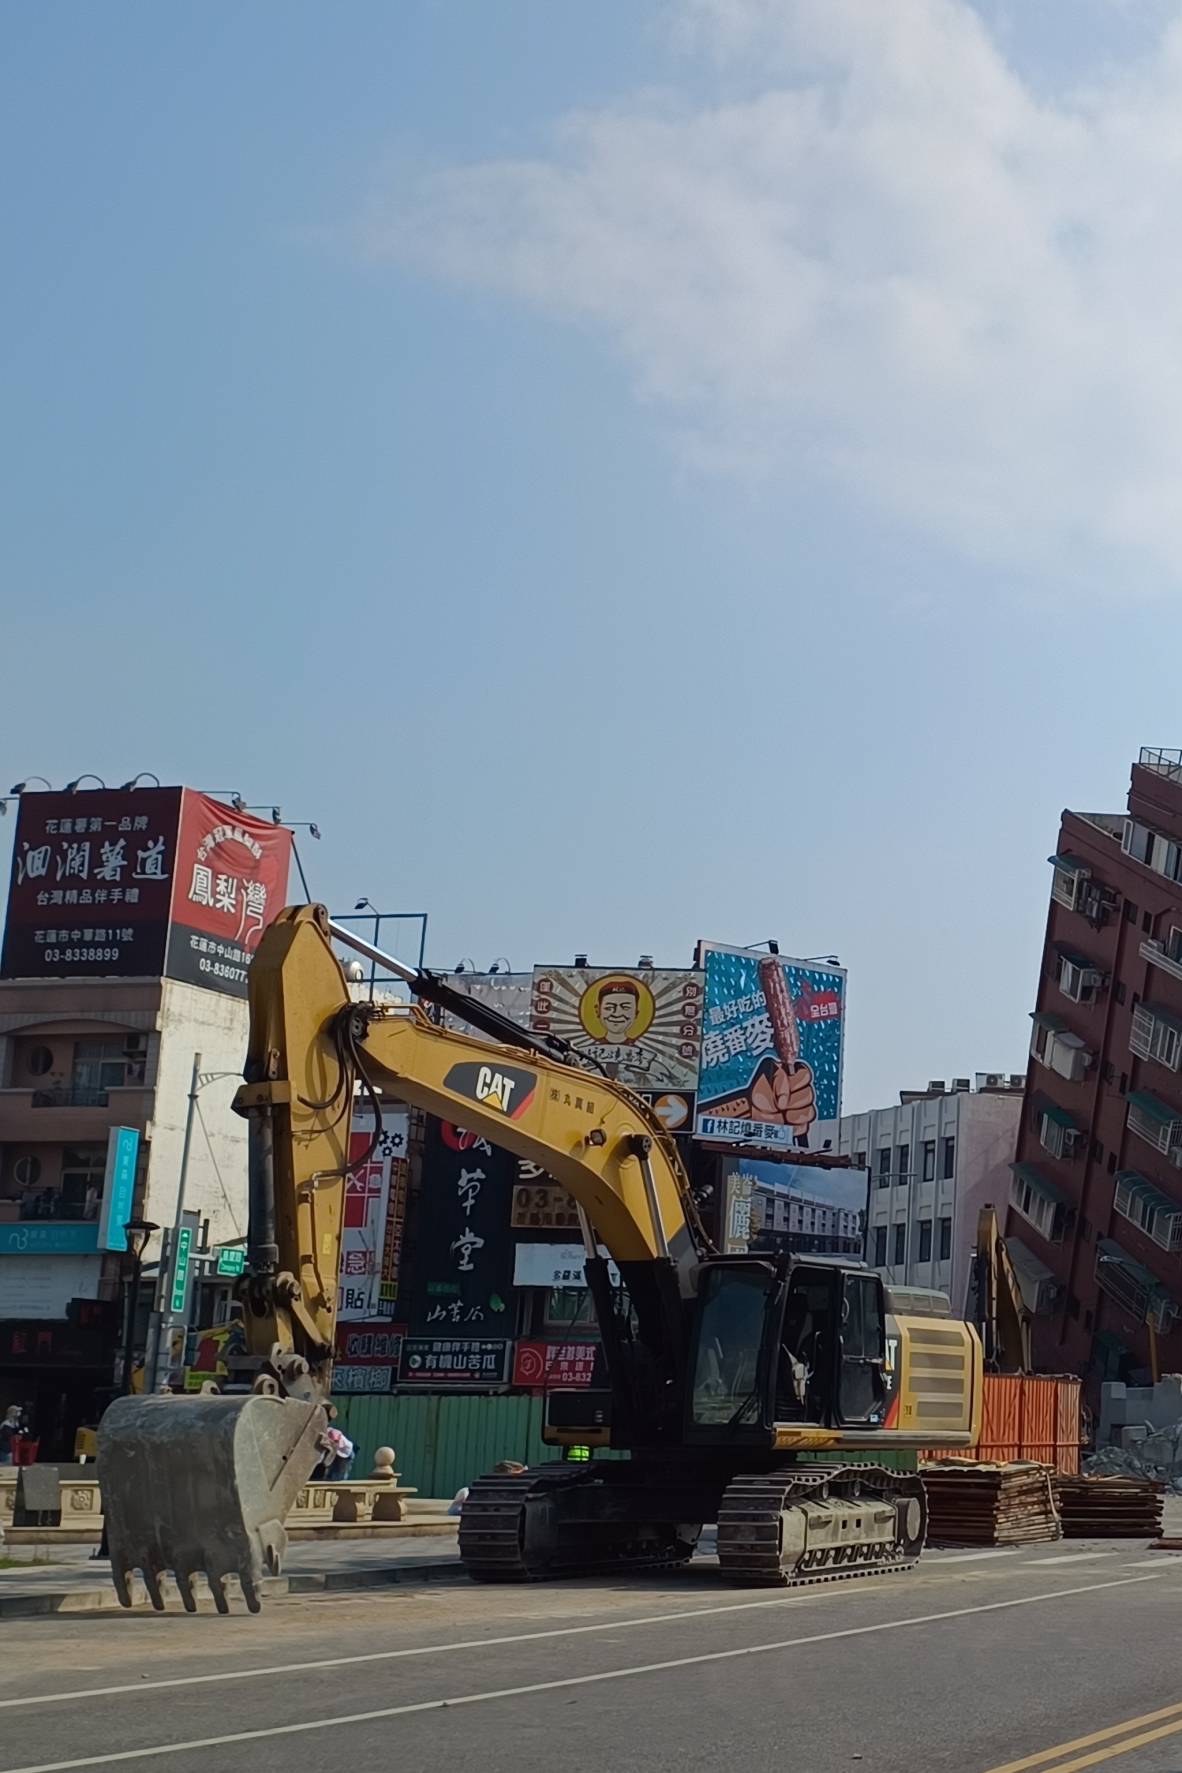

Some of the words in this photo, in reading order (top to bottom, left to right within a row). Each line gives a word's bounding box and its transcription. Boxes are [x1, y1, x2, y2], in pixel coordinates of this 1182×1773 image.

[17, 835, 170, 885] 洄瀾薯道
[36, 887, 140, 906] 台灣精品伴手禮
[34, 927, 135, 943] 花蓮市中華路11號
[44, 948, 120, 962] 03-8338899
[476, 1066, 515, 1112] CAT
[425, 1354, 497, 1370] 有機山苦瓜
